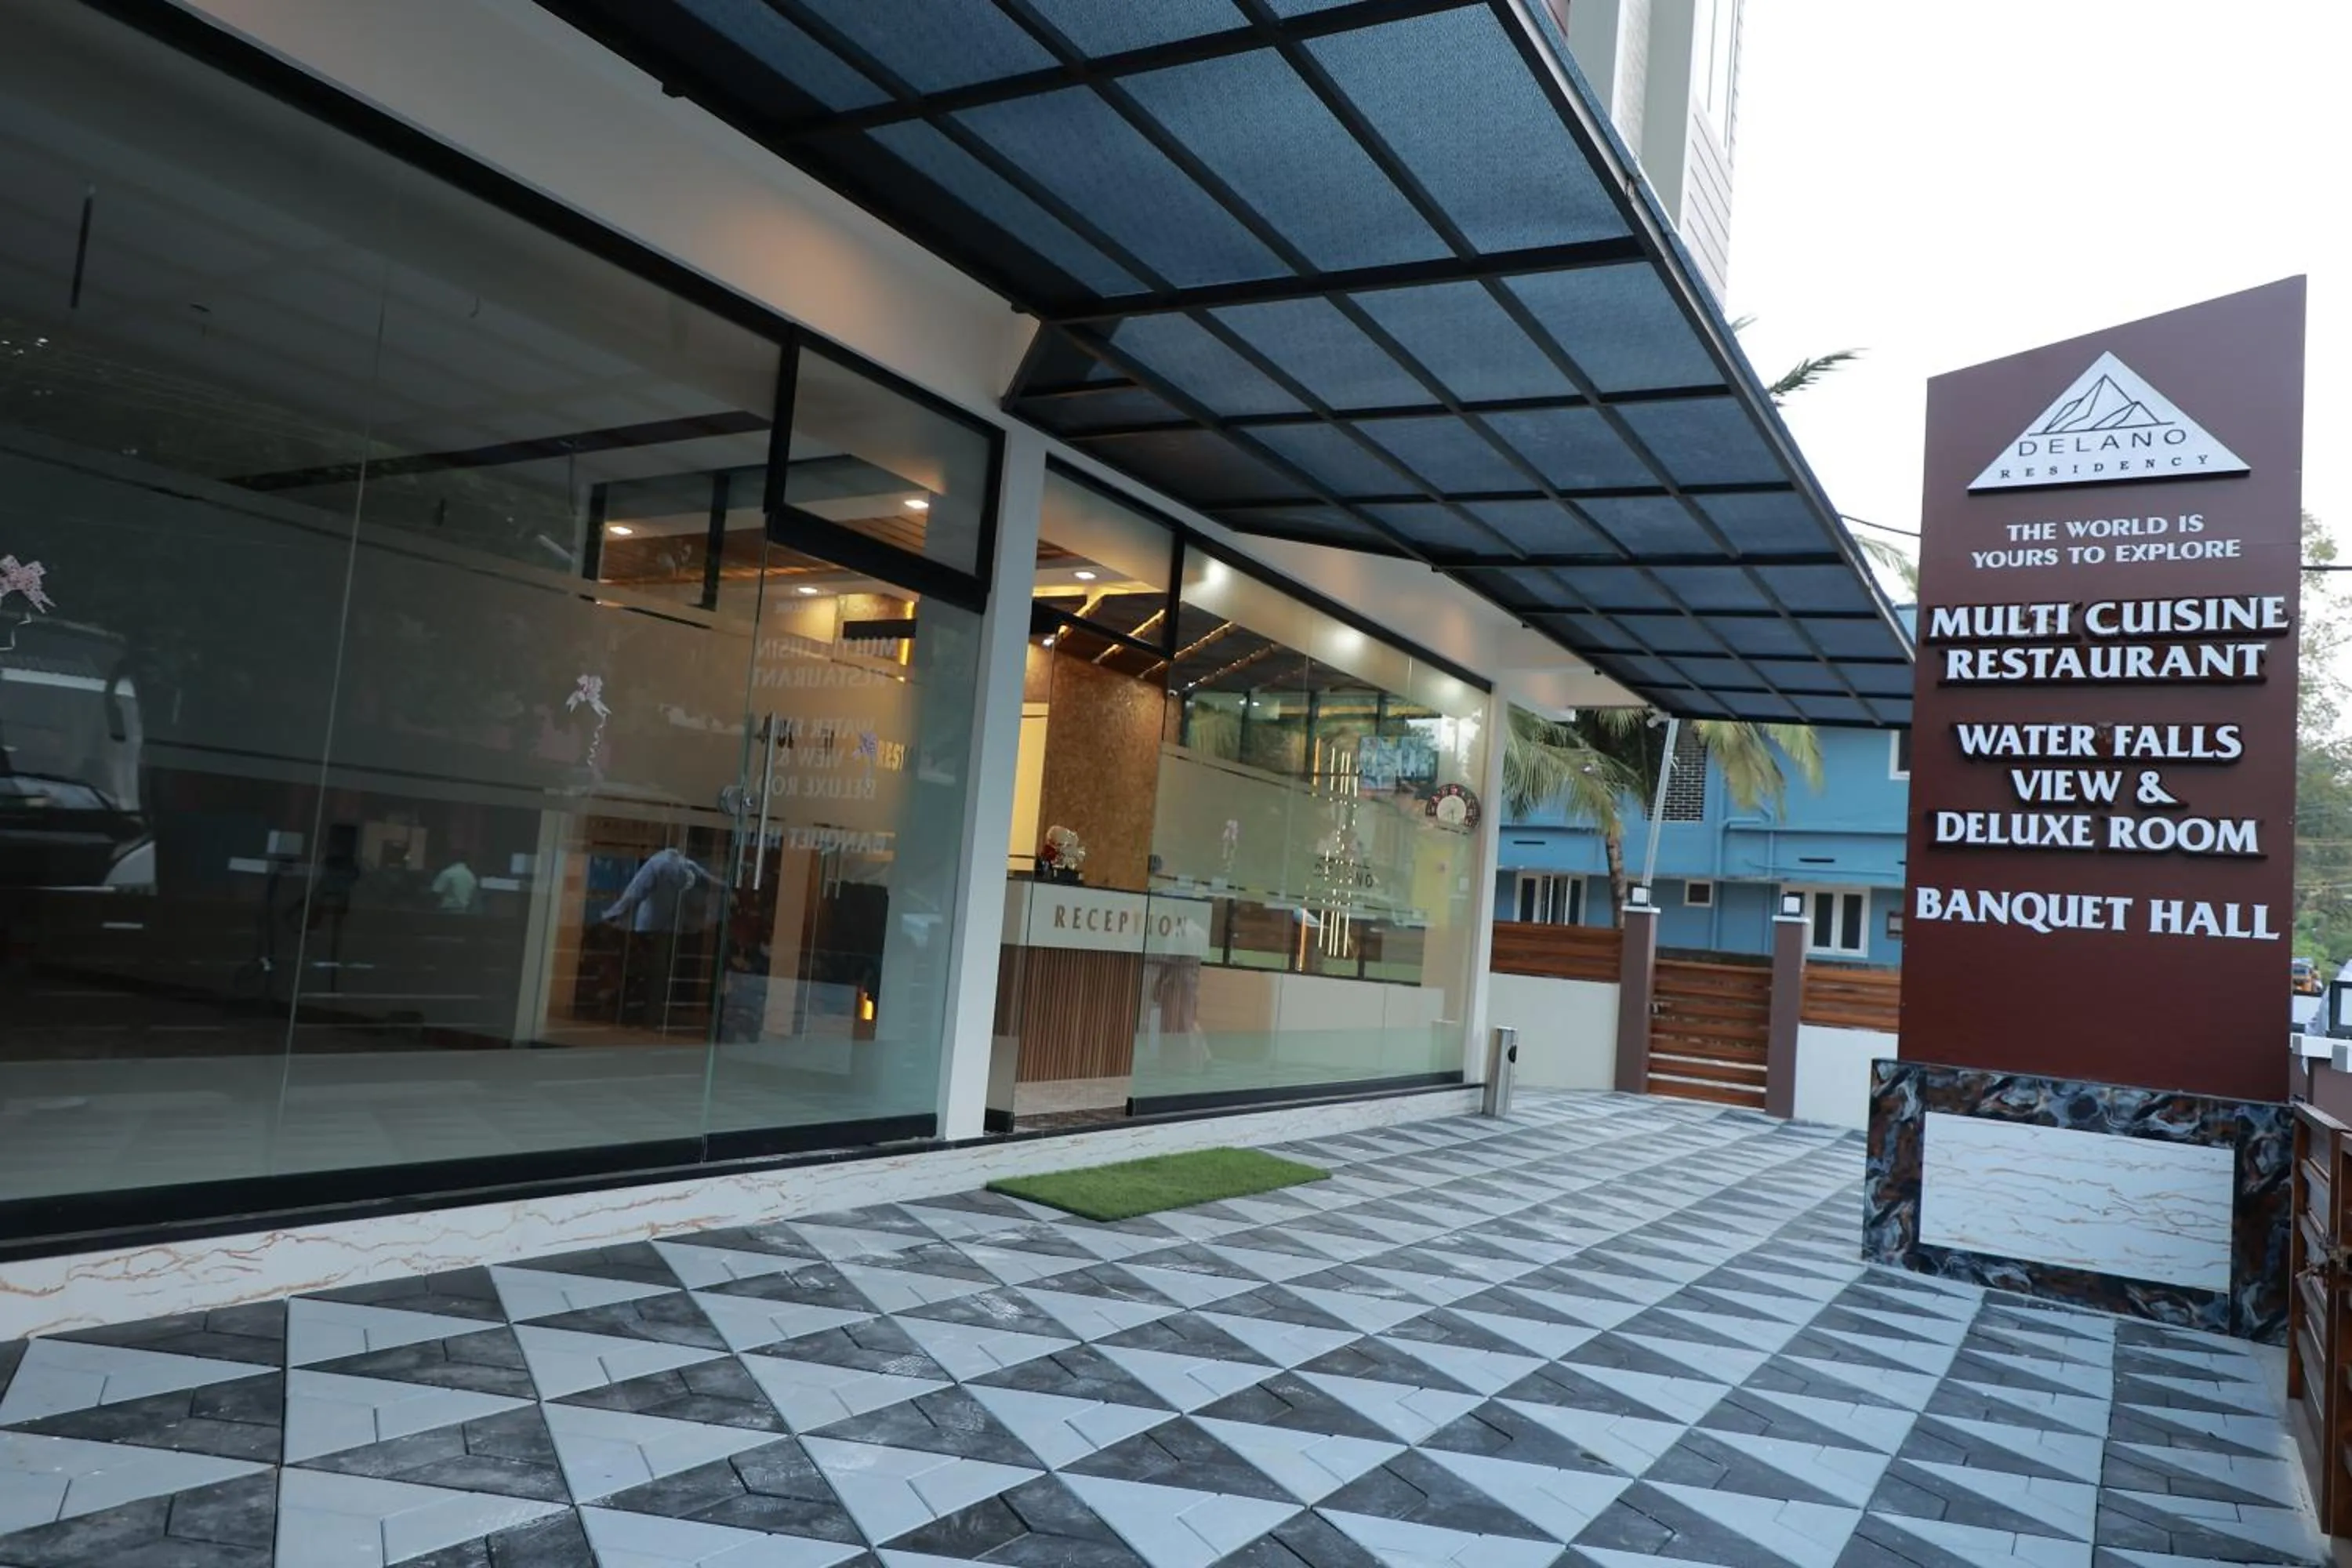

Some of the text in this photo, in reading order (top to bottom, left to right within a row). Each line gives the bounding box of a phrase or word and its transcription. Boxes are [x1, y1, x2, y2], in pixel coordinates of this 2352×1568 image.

[2018, 428, 2187, 458] DELANO
[2001, 454, 2209, 478] RESIDENCY
[2007, 514, 2205, 543] THE WORLD IS
[1972, 539, 2241, 569] YOURS TO EXPLORE
[1929, 596, 2290, 639] MULTI CUISINE
[1946, 644, 2268, 681] RESTAURANT
[1957, 724, 2243, 760] WATER FALLS
[2011, 770, 2177, 804] VIEW &
[1936, 811, 2260, 854] DELUXE ROOM
[1054, 904, 1188, 938] RECEPTION
[1916, 887, 2281, 941] BANQUET HALL
